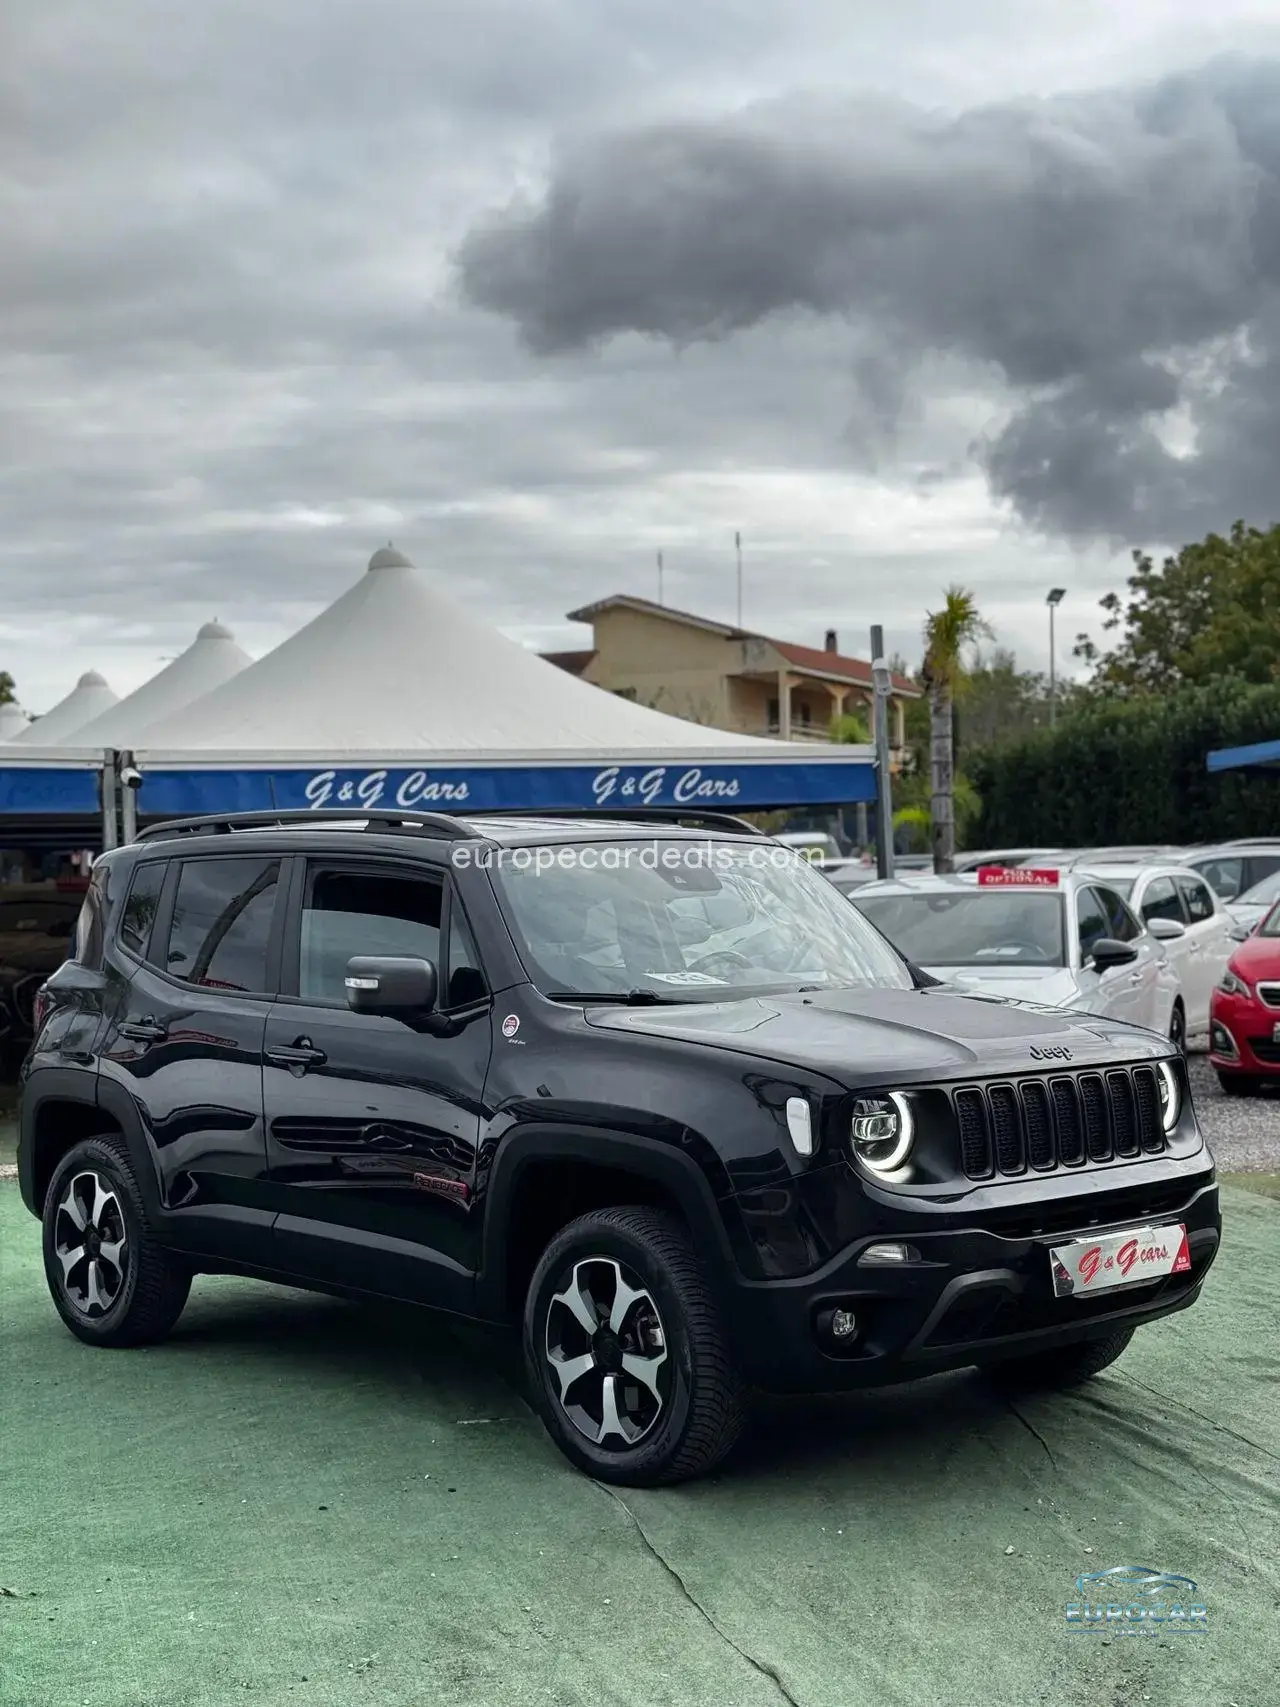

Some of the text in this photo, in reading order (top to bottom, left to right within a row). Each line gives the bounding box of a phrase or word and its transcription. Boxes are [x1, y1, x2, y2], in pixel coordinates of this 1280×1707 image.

[396, 771, 470, 806] Cars
[674, 768, 740, 802] Cars
[985, 875, 1051, 884] OPTIONAL
[1029, 1045, 1073, 1061] Jeep
[1140, 1243, 1169, 1264] cars
